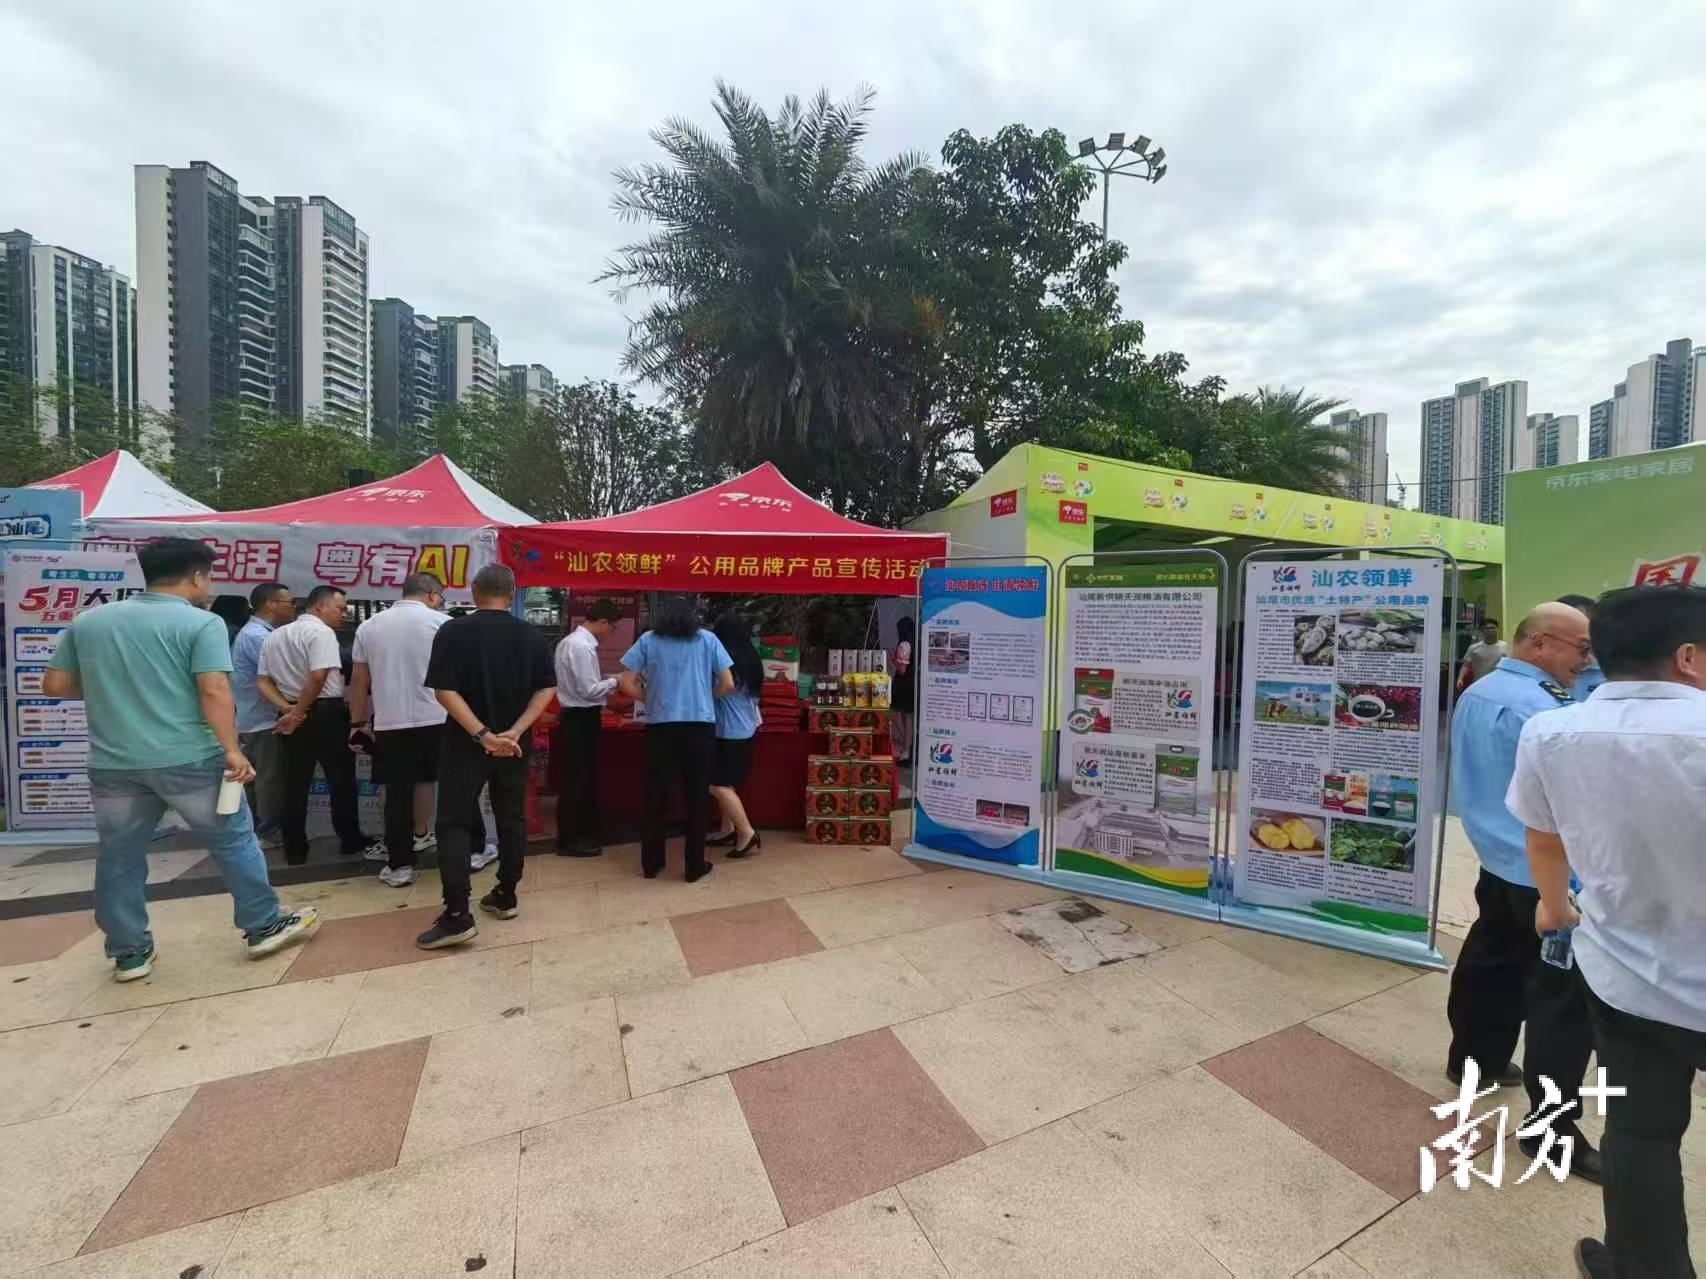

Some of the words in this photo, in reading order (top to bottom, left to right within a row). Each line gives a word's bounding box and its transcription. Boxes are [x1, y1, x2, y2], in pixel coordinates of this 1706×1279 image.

[1546, 457, 1695, 491] 京东家电家居
[314, 542, 471, 588] 粤有AI
[1312, 568, 1413, 588] 汕农领鲜
